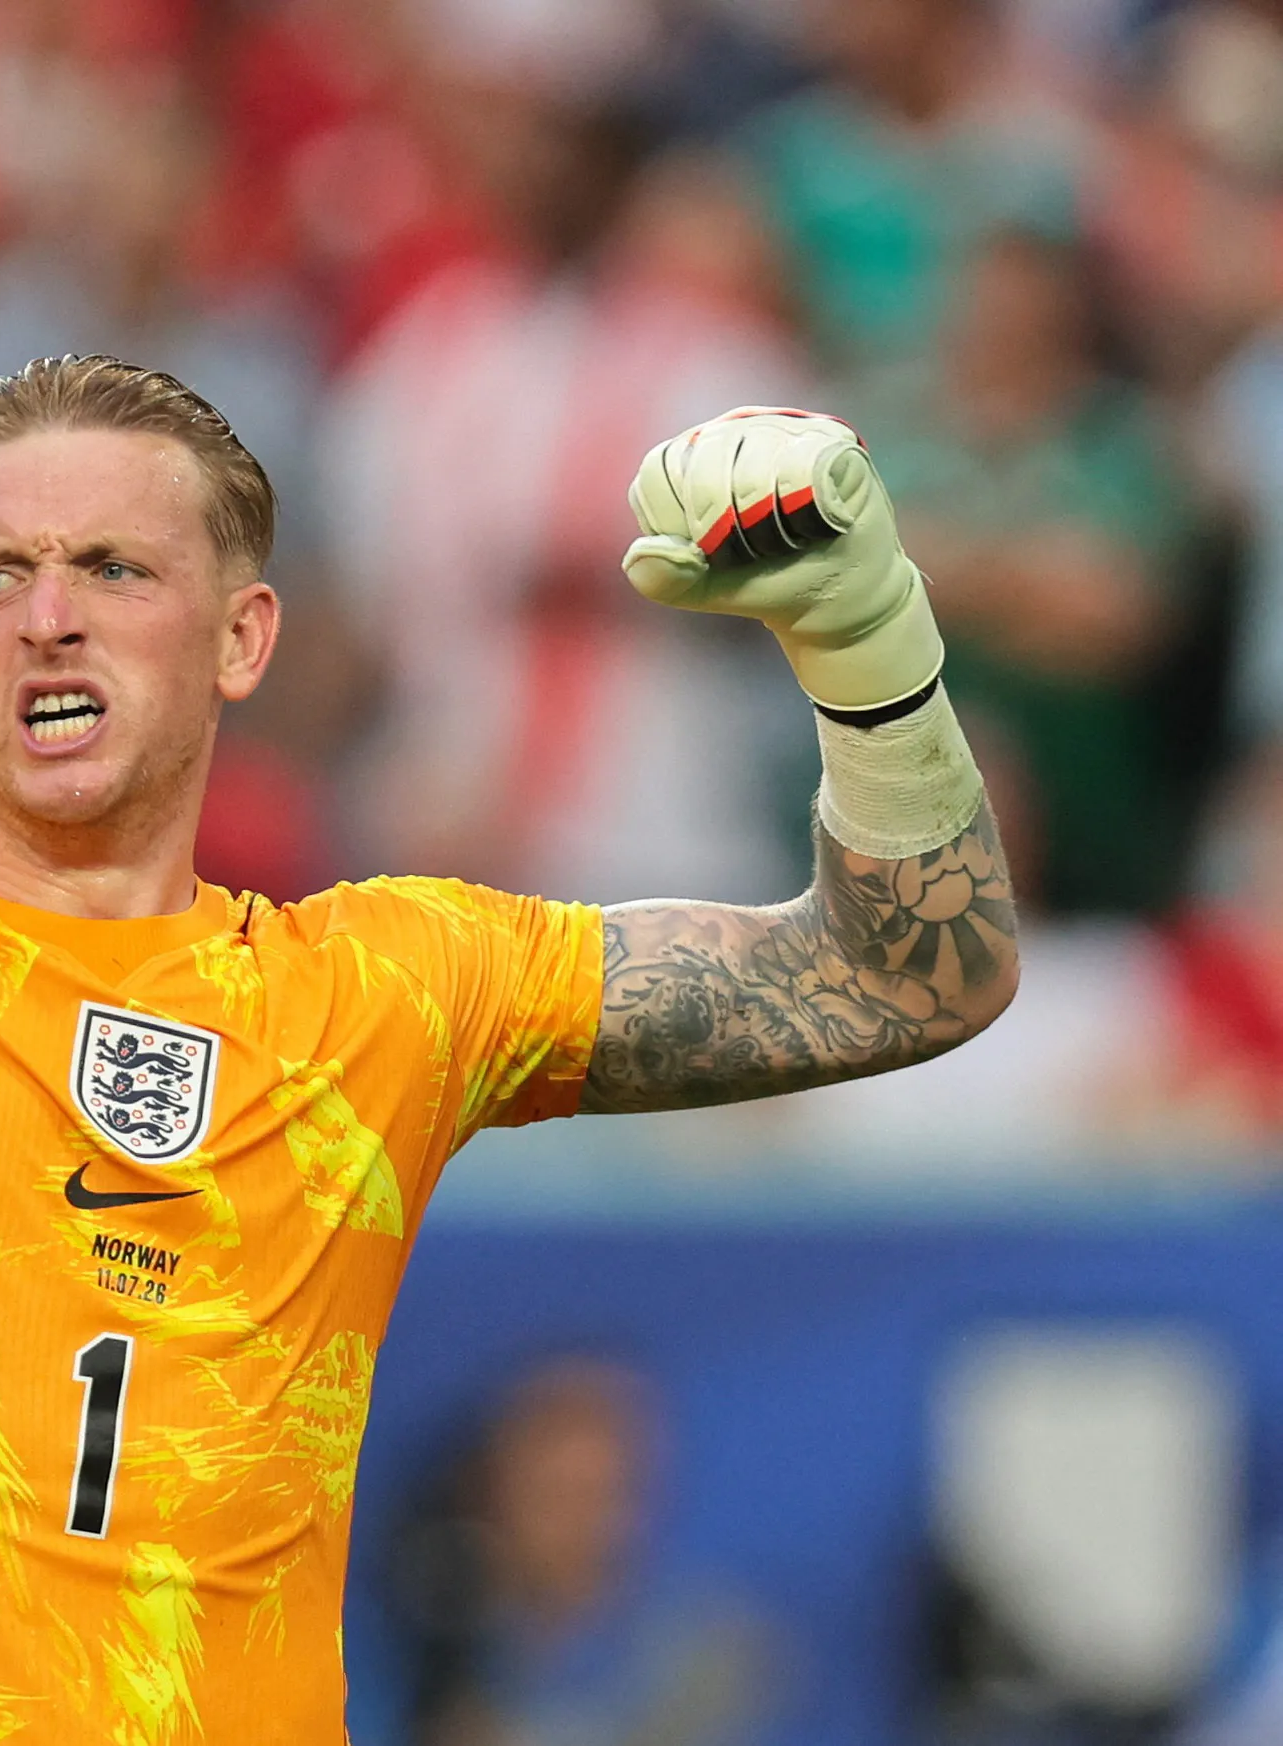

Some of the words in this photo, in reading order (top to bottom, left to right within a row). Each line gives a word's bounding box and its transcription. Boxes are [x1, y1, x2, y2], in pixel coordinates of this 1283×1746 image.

[91, 1233, 182, 1276] NORWAY
[97, 1267, 167, 1305] 11.07.26
[65, 1332, 135, 1539] 1
